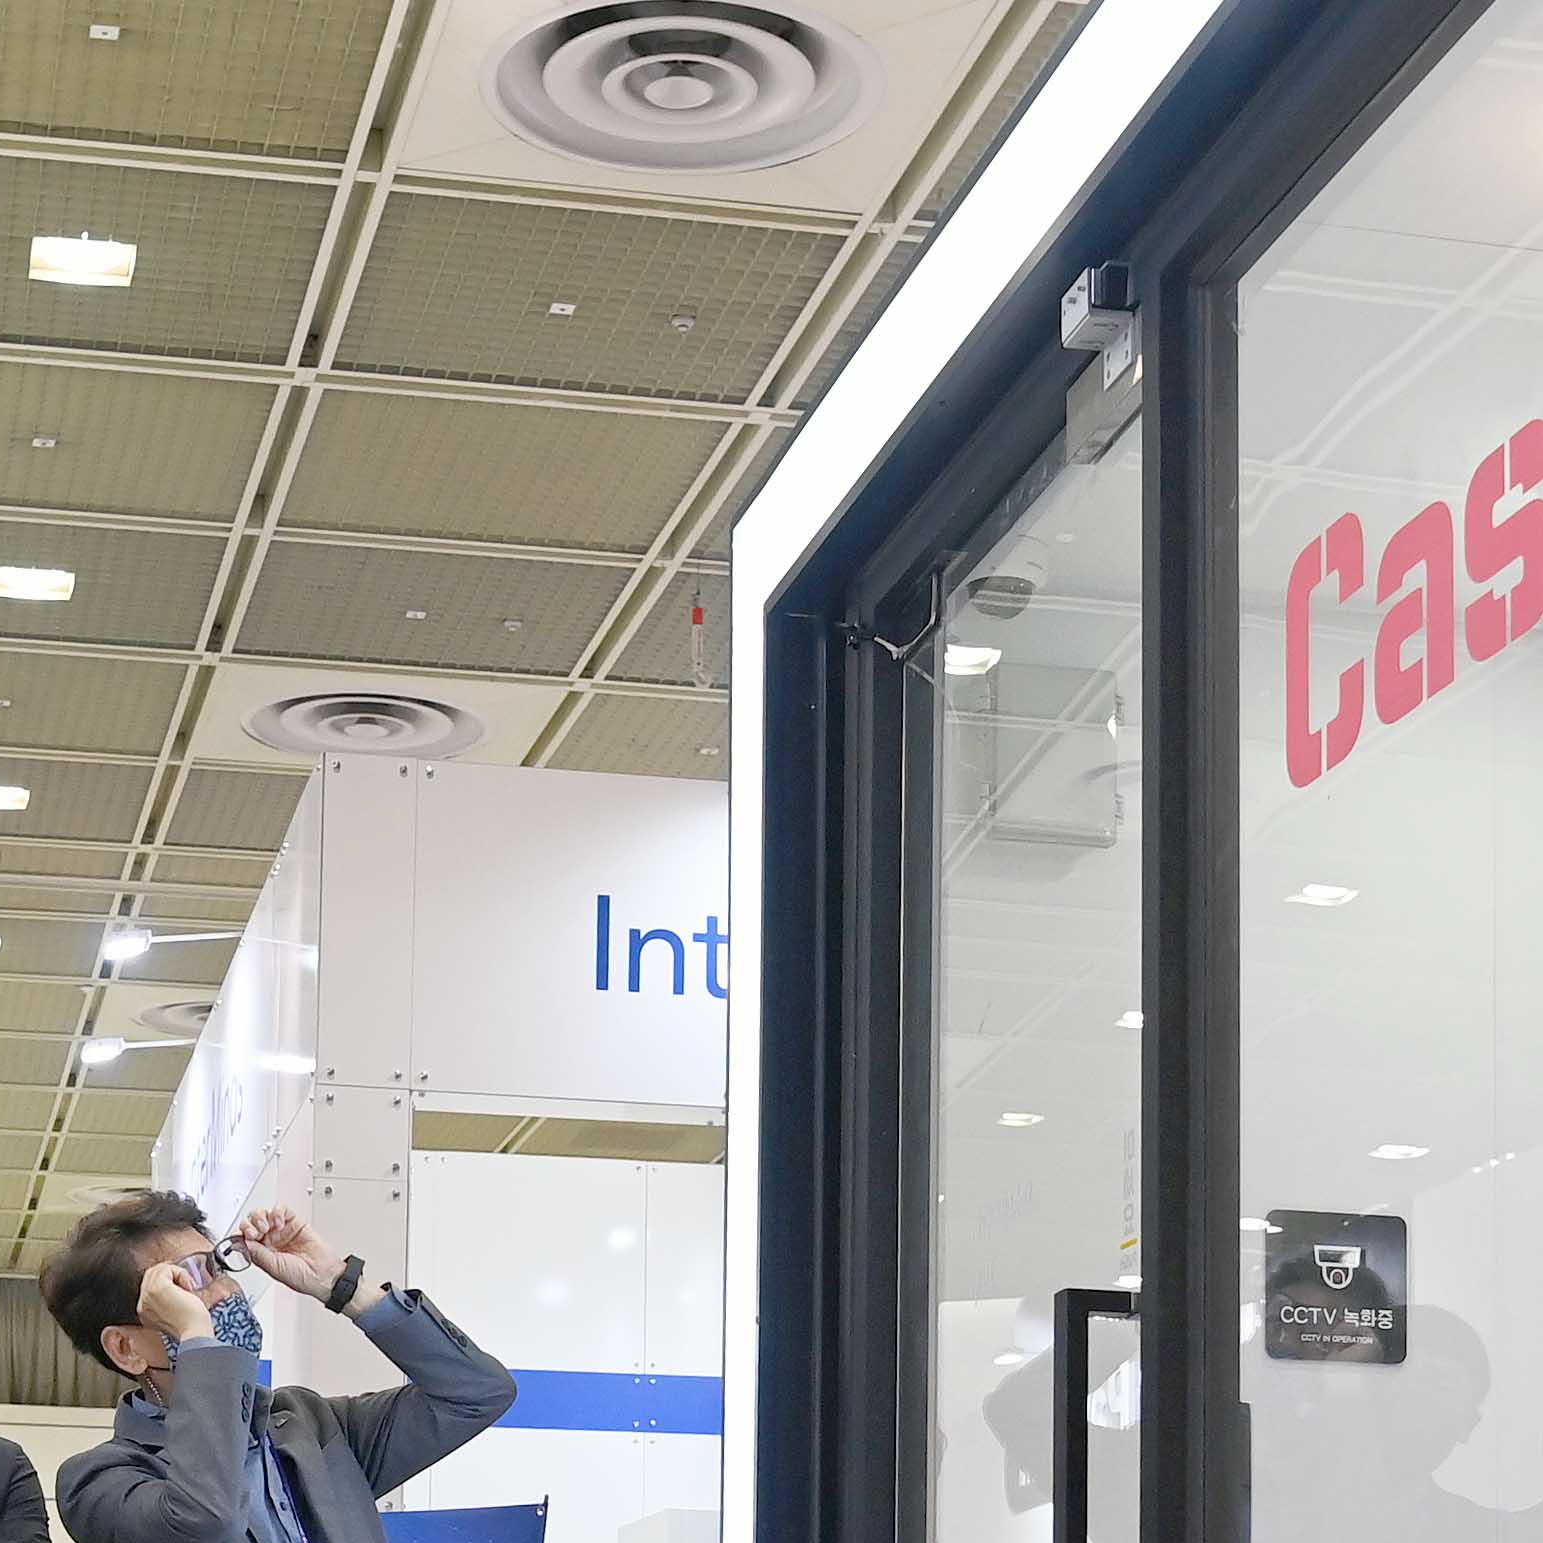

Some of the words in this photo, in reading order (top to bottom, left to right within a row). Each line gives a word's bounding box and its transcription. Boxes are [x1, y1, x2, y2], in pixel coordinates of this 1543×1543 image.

[596, 894, 728, 999] Int
[1280, 1306, 1337, 1325] CCTV
[1343, 1308, 1394, 1330] 녹화중
[1300, 1334, 1321, 1343] CCTV
[1332, 1335, 1374, 1345] OPERATION
